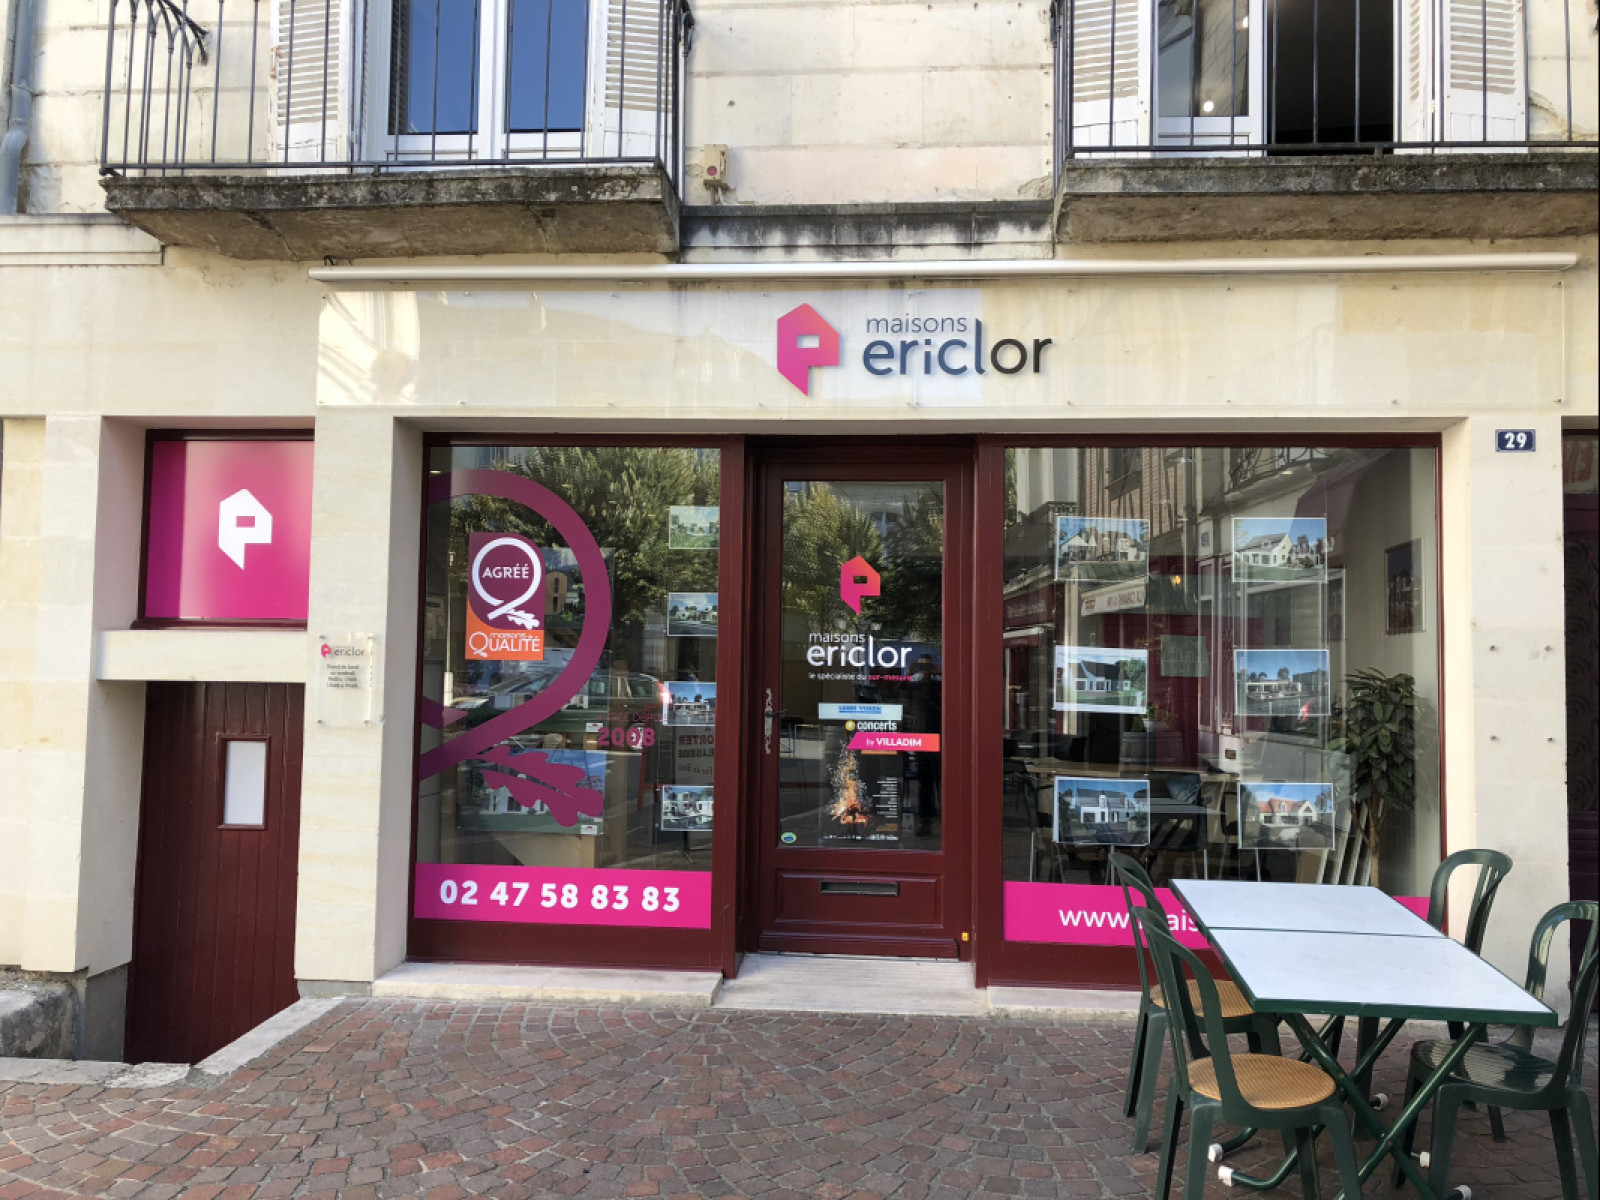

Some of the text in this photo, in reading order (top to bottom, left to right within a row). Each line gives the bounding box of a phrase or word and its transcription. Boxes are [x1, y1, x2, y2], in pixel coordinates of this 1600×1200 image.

[866, 314, 967, 334] maisons
[863, 317, 1053, 376] ericlor
[1504, 432, 1527, 448] 29
[482, 563, 530, 579] AGRÉÉ
[468, 631, 540, 657] QUALITÉ
[809, 631, 866, 643] maisons
[806, 635, 912, 668] ericlor
[857, 720, 898, 731] concerts
[597, 727, 655, 746] 2008
[866, 738, 922, 747] by VILLADIM
[440, 880, 680, 912] 02 47 58 83 83
